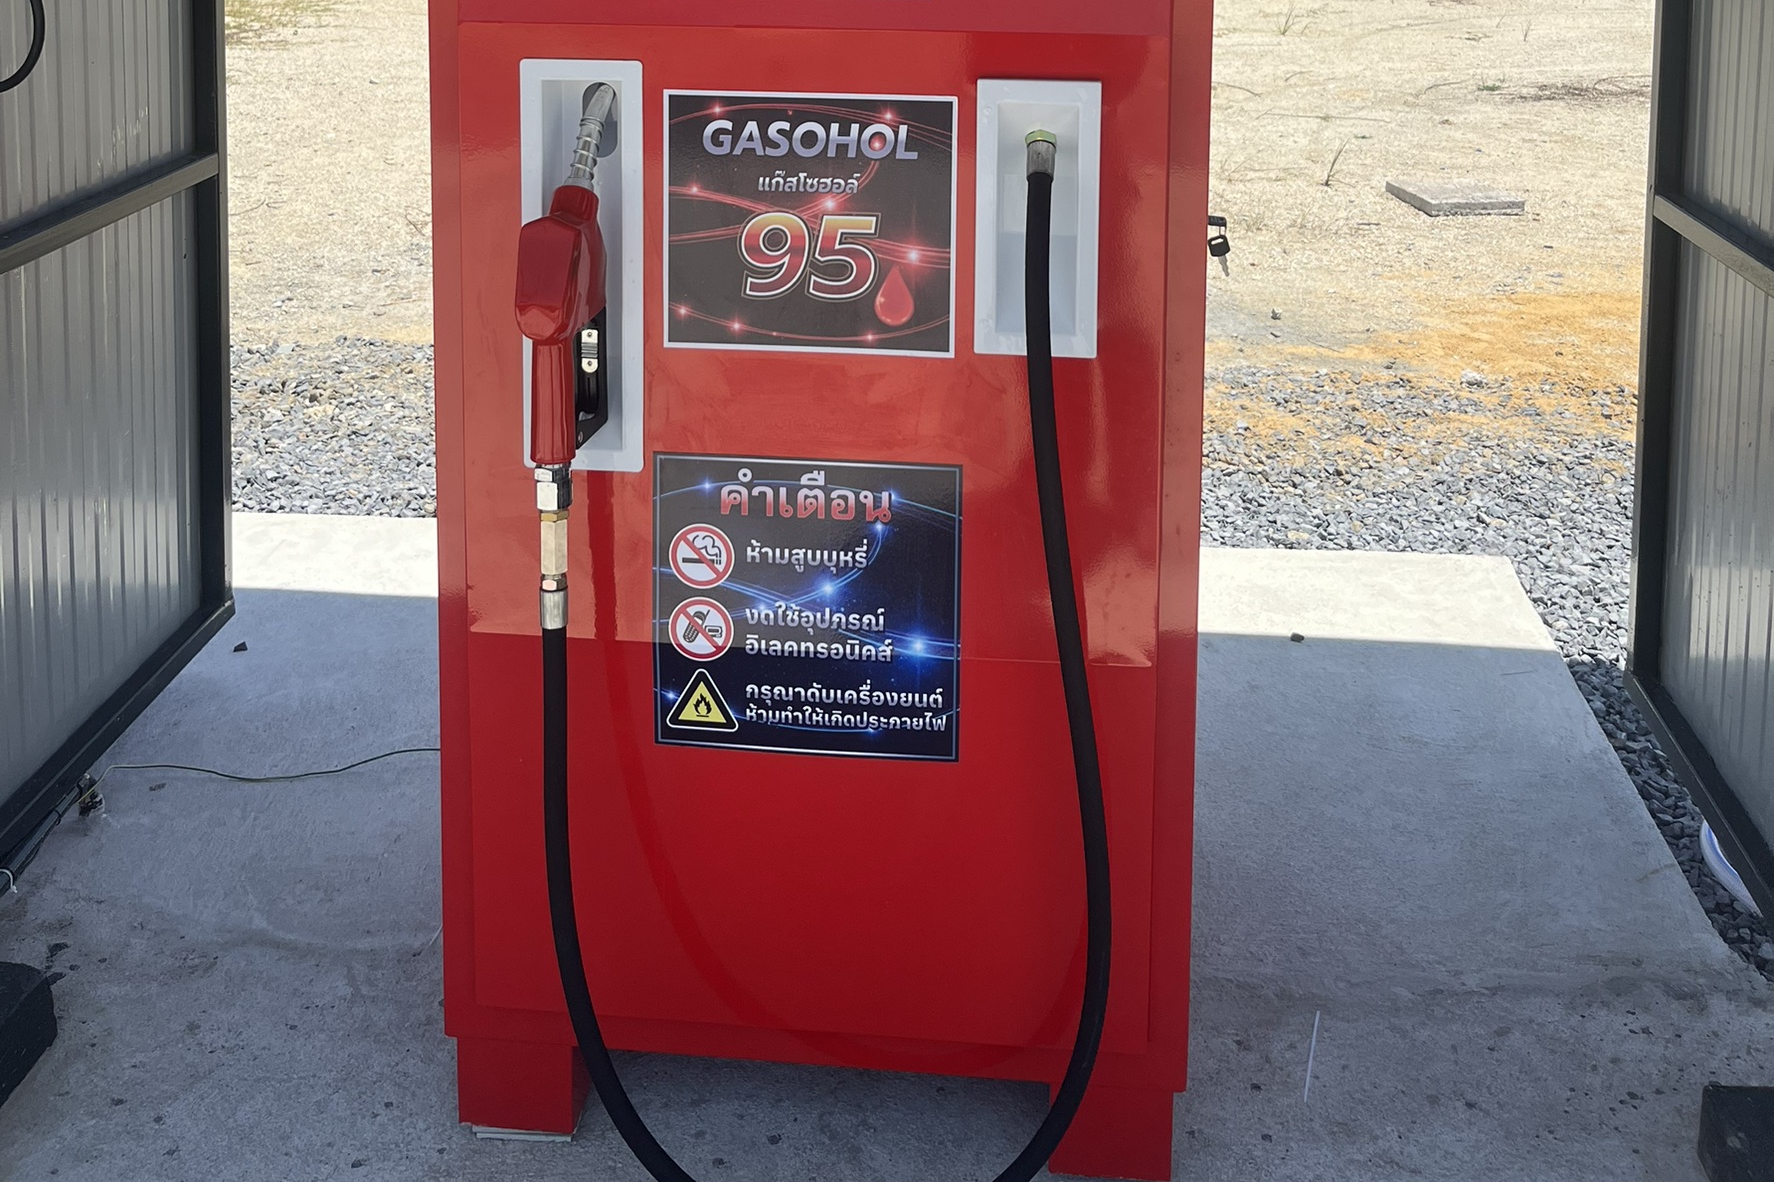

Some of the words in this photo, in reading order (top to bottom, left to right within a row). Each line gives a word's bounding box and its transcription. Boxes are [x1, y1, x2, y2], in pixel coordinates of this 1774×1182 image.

[702, 120, 918, 159] GASOHOL
[757, 170, 861, 194] แก๊สโซฮอล์
[739, 210, 878, 300] 95
[720, 468, 892, 523] คำเตือน
[746, 539, 868, 574] ห้ามสูบบุหรี่
[745, 602, 885, 634] งดใช้อุปกรณ์
[745, 635, 893, 662] อิเลคทรอนิคส์
[745, 679, 943, 708] กรุณาดับเครื่องยนต์
[745, 702, 947, 732] ห้ามทำให้เกิดประกายไฟ
